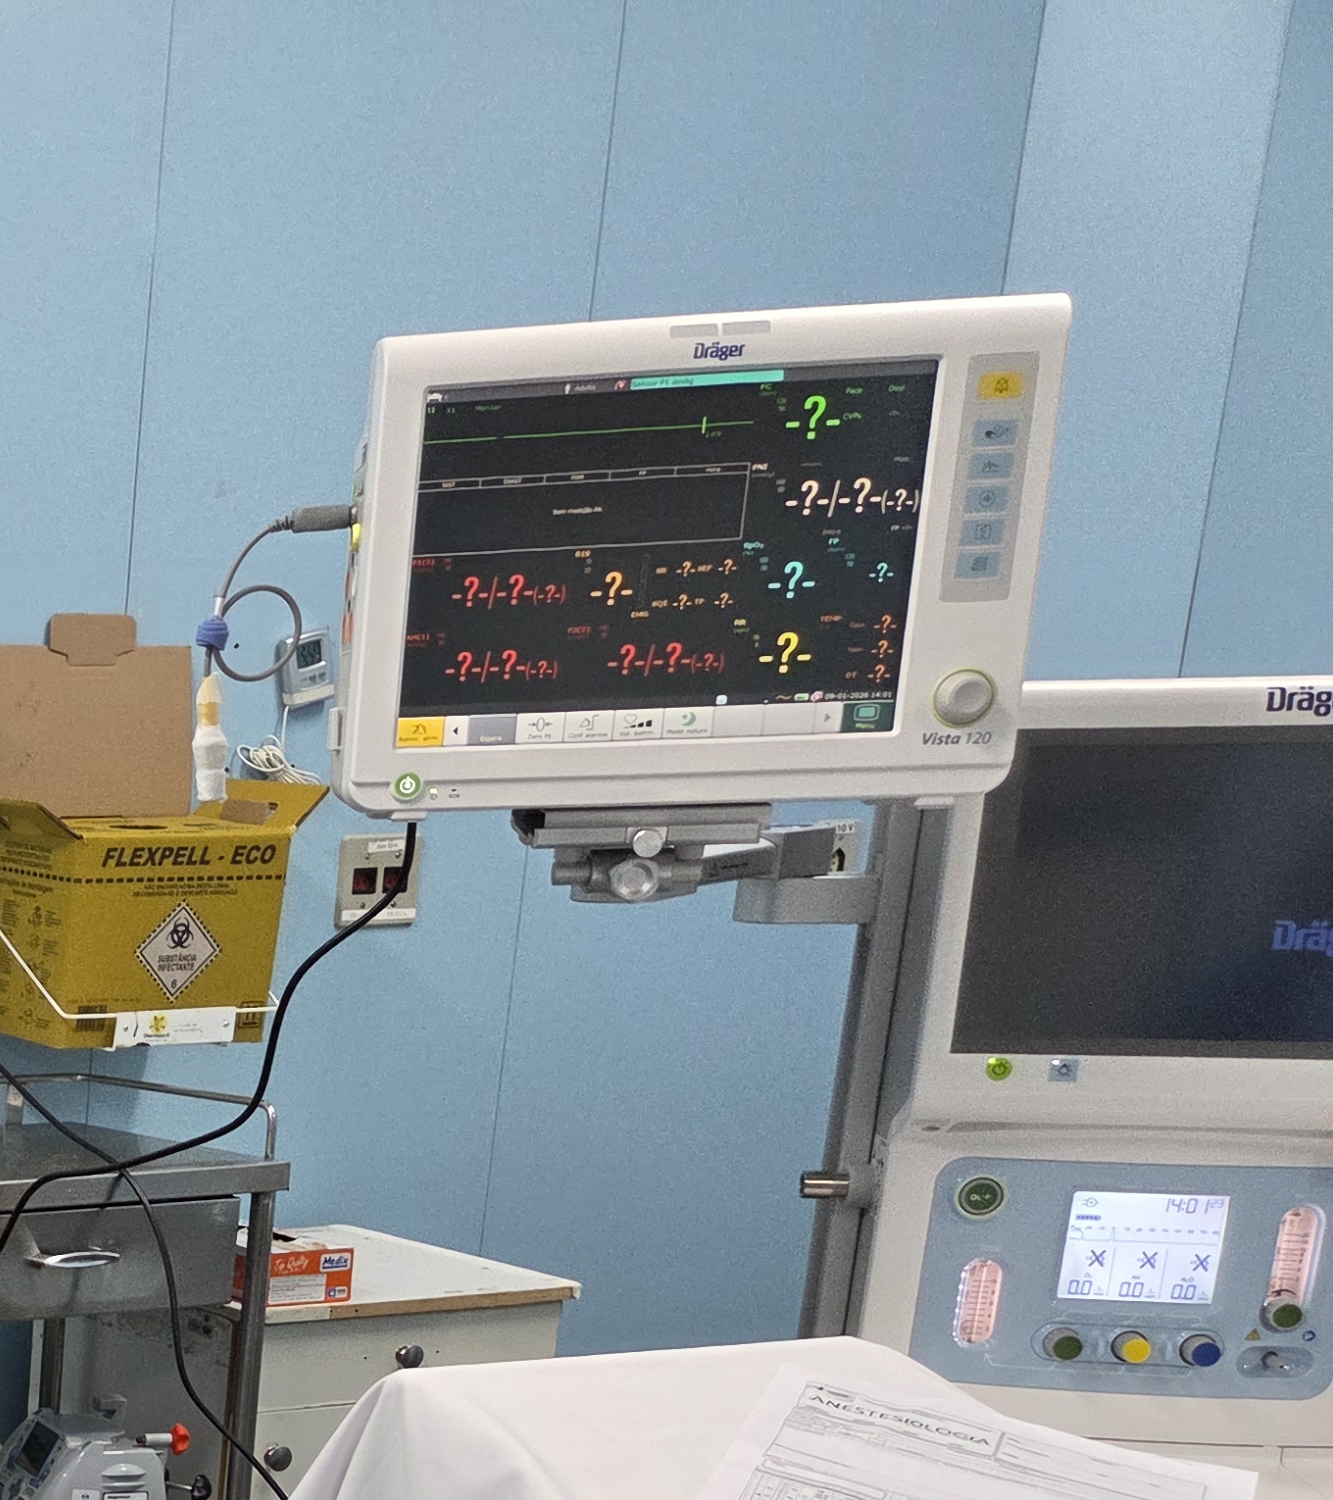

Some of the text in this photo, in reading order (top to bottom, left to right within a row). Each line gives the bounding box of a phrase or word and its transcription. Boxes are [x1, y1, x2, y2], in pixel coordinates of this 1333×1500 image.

[693, 342, 746, 361] Dräger
[1266, 686, 1333, 717] Dräg
[921, 731, 992, 746] Vista 120
[101, 846, 212, 868] FLEXPELL
[229, 844, 277, 865] ECO
[170, 979, 178, 989] 6
[1165, 1197, 1210, 1214] 14:01
[809, 1394, 991, 1447] ANESTESIOLOGIA
